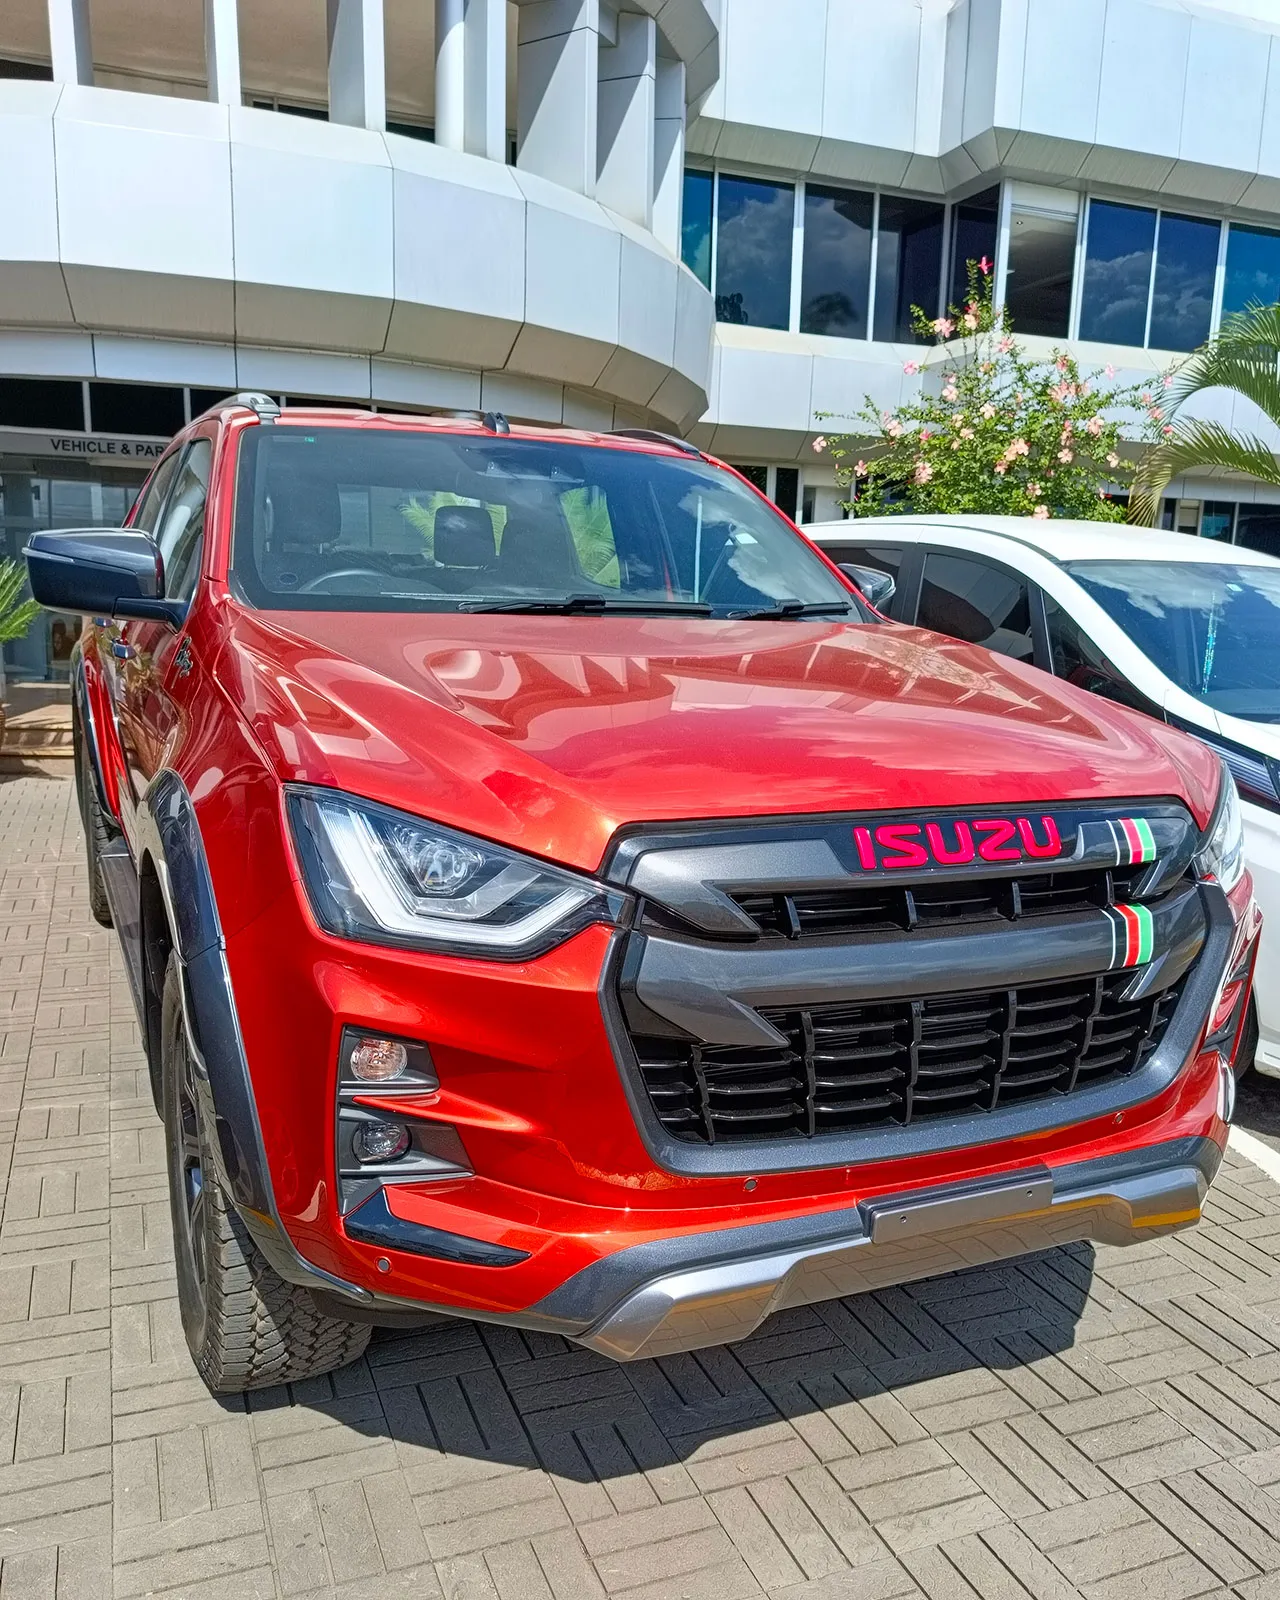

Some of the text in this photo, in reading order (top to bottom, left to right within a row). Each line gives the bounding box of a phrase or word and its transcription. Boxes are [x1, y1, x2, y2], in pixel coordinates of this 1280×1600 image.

[51, 439, 116, 454] VEHICLE
[121, 444, 131, 455] &
[853, 816, 1062, 870] ISUZU
